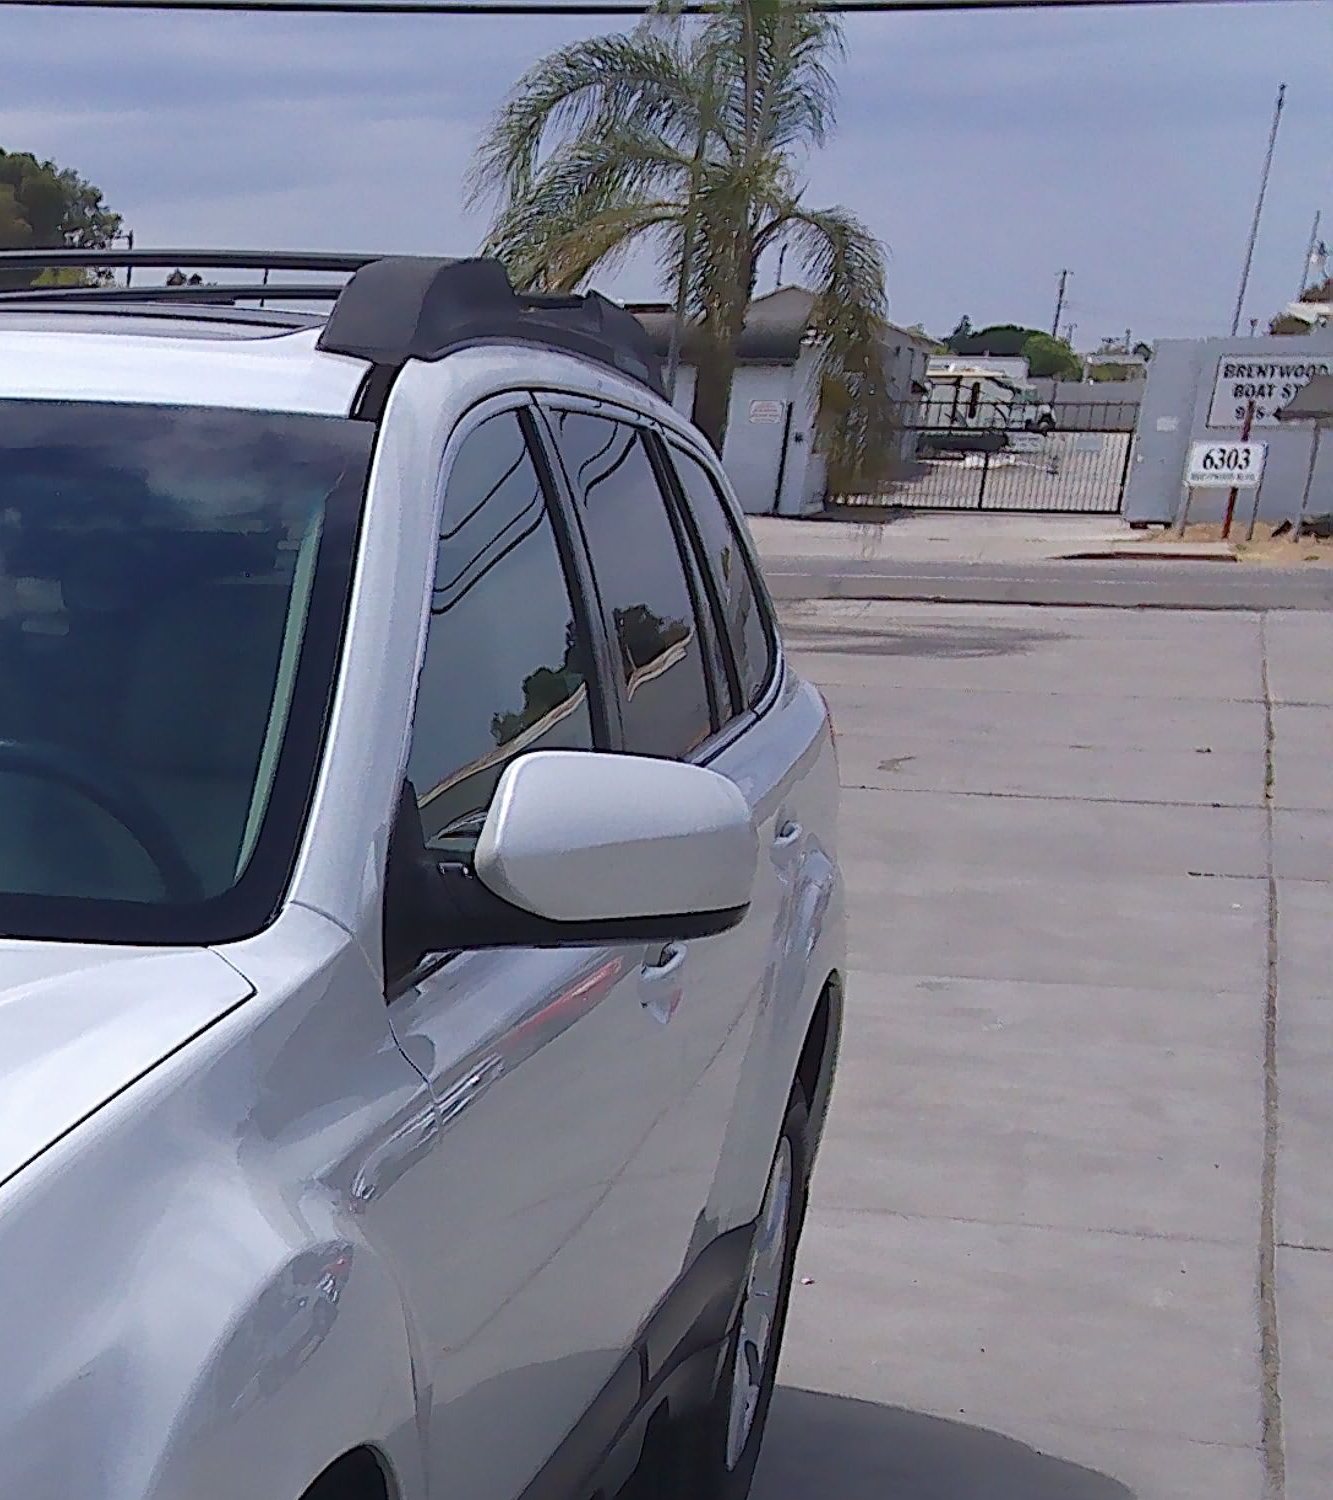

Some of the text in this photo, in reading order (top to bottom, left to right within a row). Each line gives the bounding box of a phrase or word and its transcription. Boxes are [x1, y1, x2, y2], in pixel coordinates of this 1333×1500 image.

[1223, 363, 1331, 379] BRENTWOOD
[1233, 383, 1276, 398] BOAT
[1202, 448, 1251, 470] 6303
